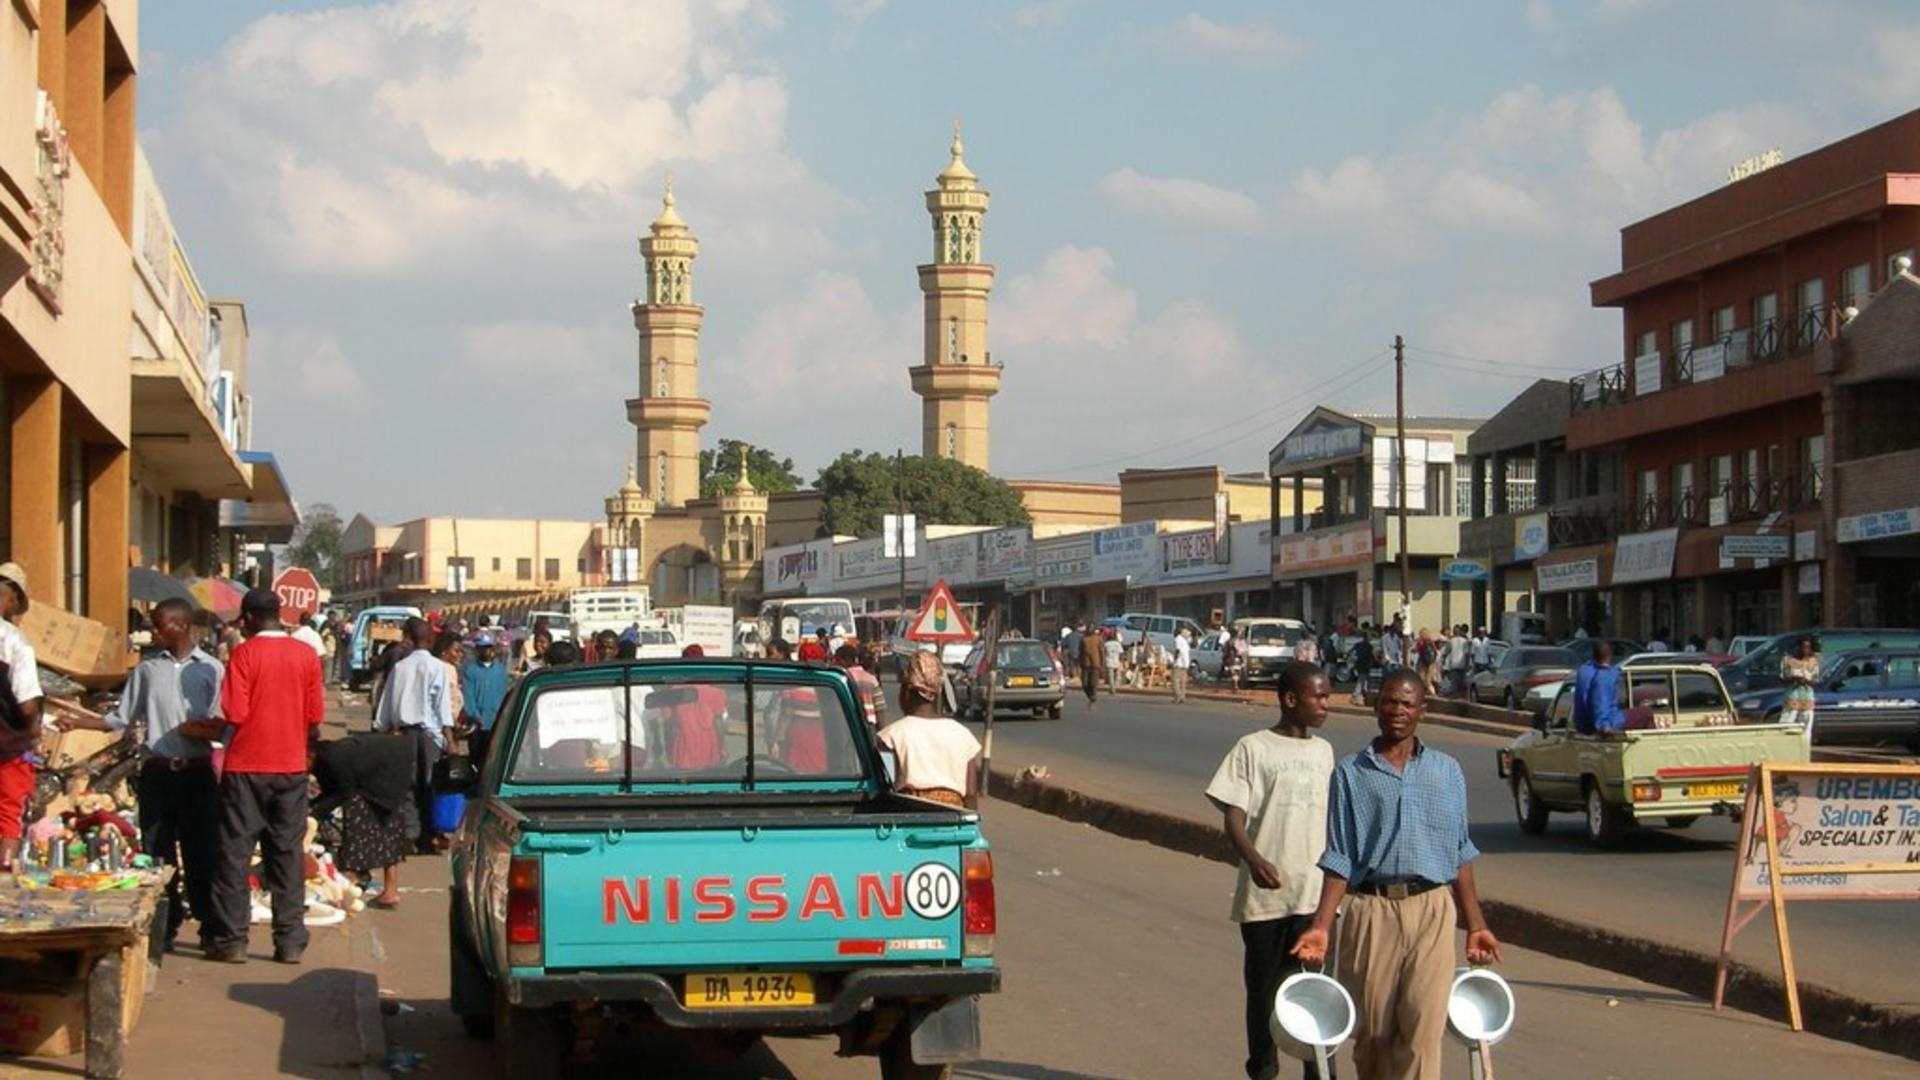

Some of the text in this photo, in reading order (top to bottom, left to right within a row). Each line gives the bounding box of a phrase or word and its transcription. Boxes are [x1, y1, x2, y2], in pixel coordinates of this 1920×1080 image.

[277, 585, 316, 609] STOP
[1659, 743, 1771, 765] TOYOTA
[1819, 804, 1873, 827] Salon
[1873, 805, 1889, 826] &
[1799, 830, 1896, 847] SPECIALIST
[602, 873, 905, 923] NISSAN
[916, 872, 952, 909] 80
[705, 975, 796, 1002] DA 1936
